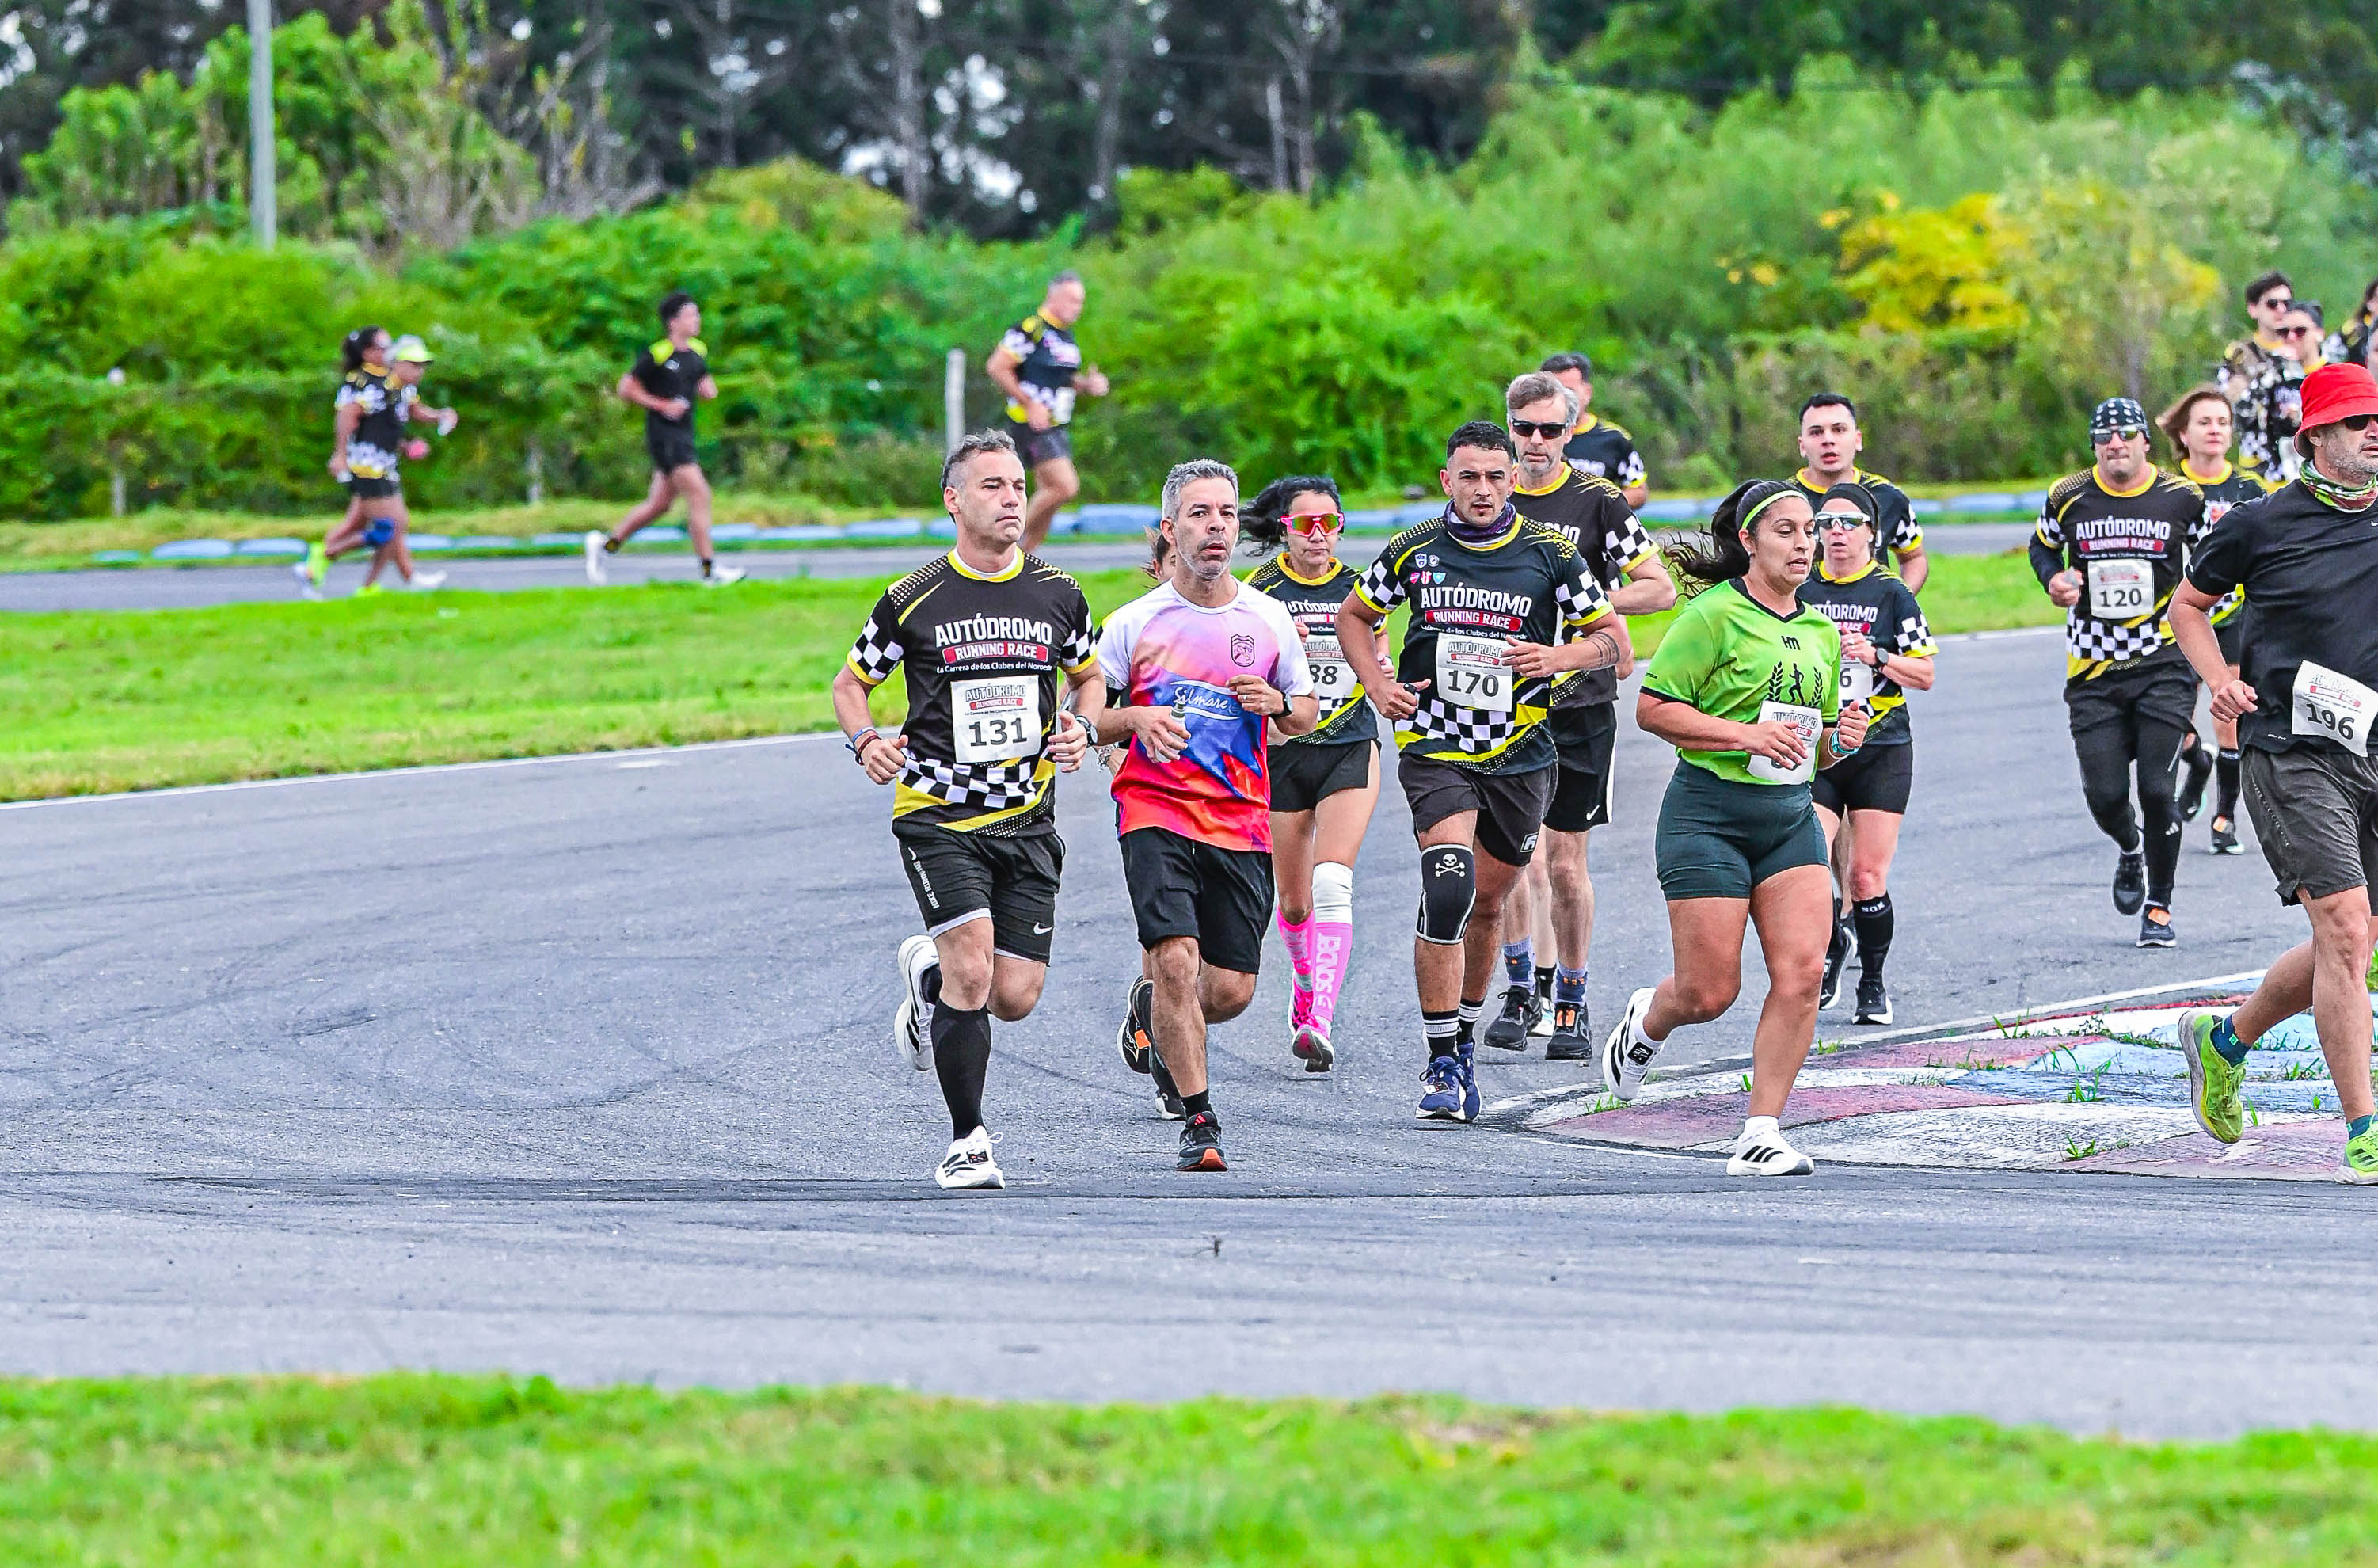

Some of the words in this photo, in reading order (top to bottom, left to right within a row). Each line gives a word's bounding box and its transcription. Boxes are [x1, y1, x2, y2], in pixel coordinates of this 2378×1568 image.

[2076, 515, 2171, 540] AUTÓDROMO
[1421, 582, 1532, 617] AUTÓDROMO
[2100, 588, 2142, 607] 120
[934, 612, 1052, 648] AUTÓDROMO
[1433, 611, 1479, 623] RUNNING
[1482, 614, 1512, 629] RACE
[1466, 629, 1488, 637] Clubes
[955, 643, 1005, 660] RUNNING
[1007, 643, 1038, 658] RACE
[965, 683, 1026, 702] AUTÓDROMO
[1448, 670, 1499, 697] 170
[1173, 687, 1228, 709] Silmare
[969, 717, 1027, 746] 131
[2306, 703, 2355, 740] 196
[1862, 901, 1885, 913] SOX
